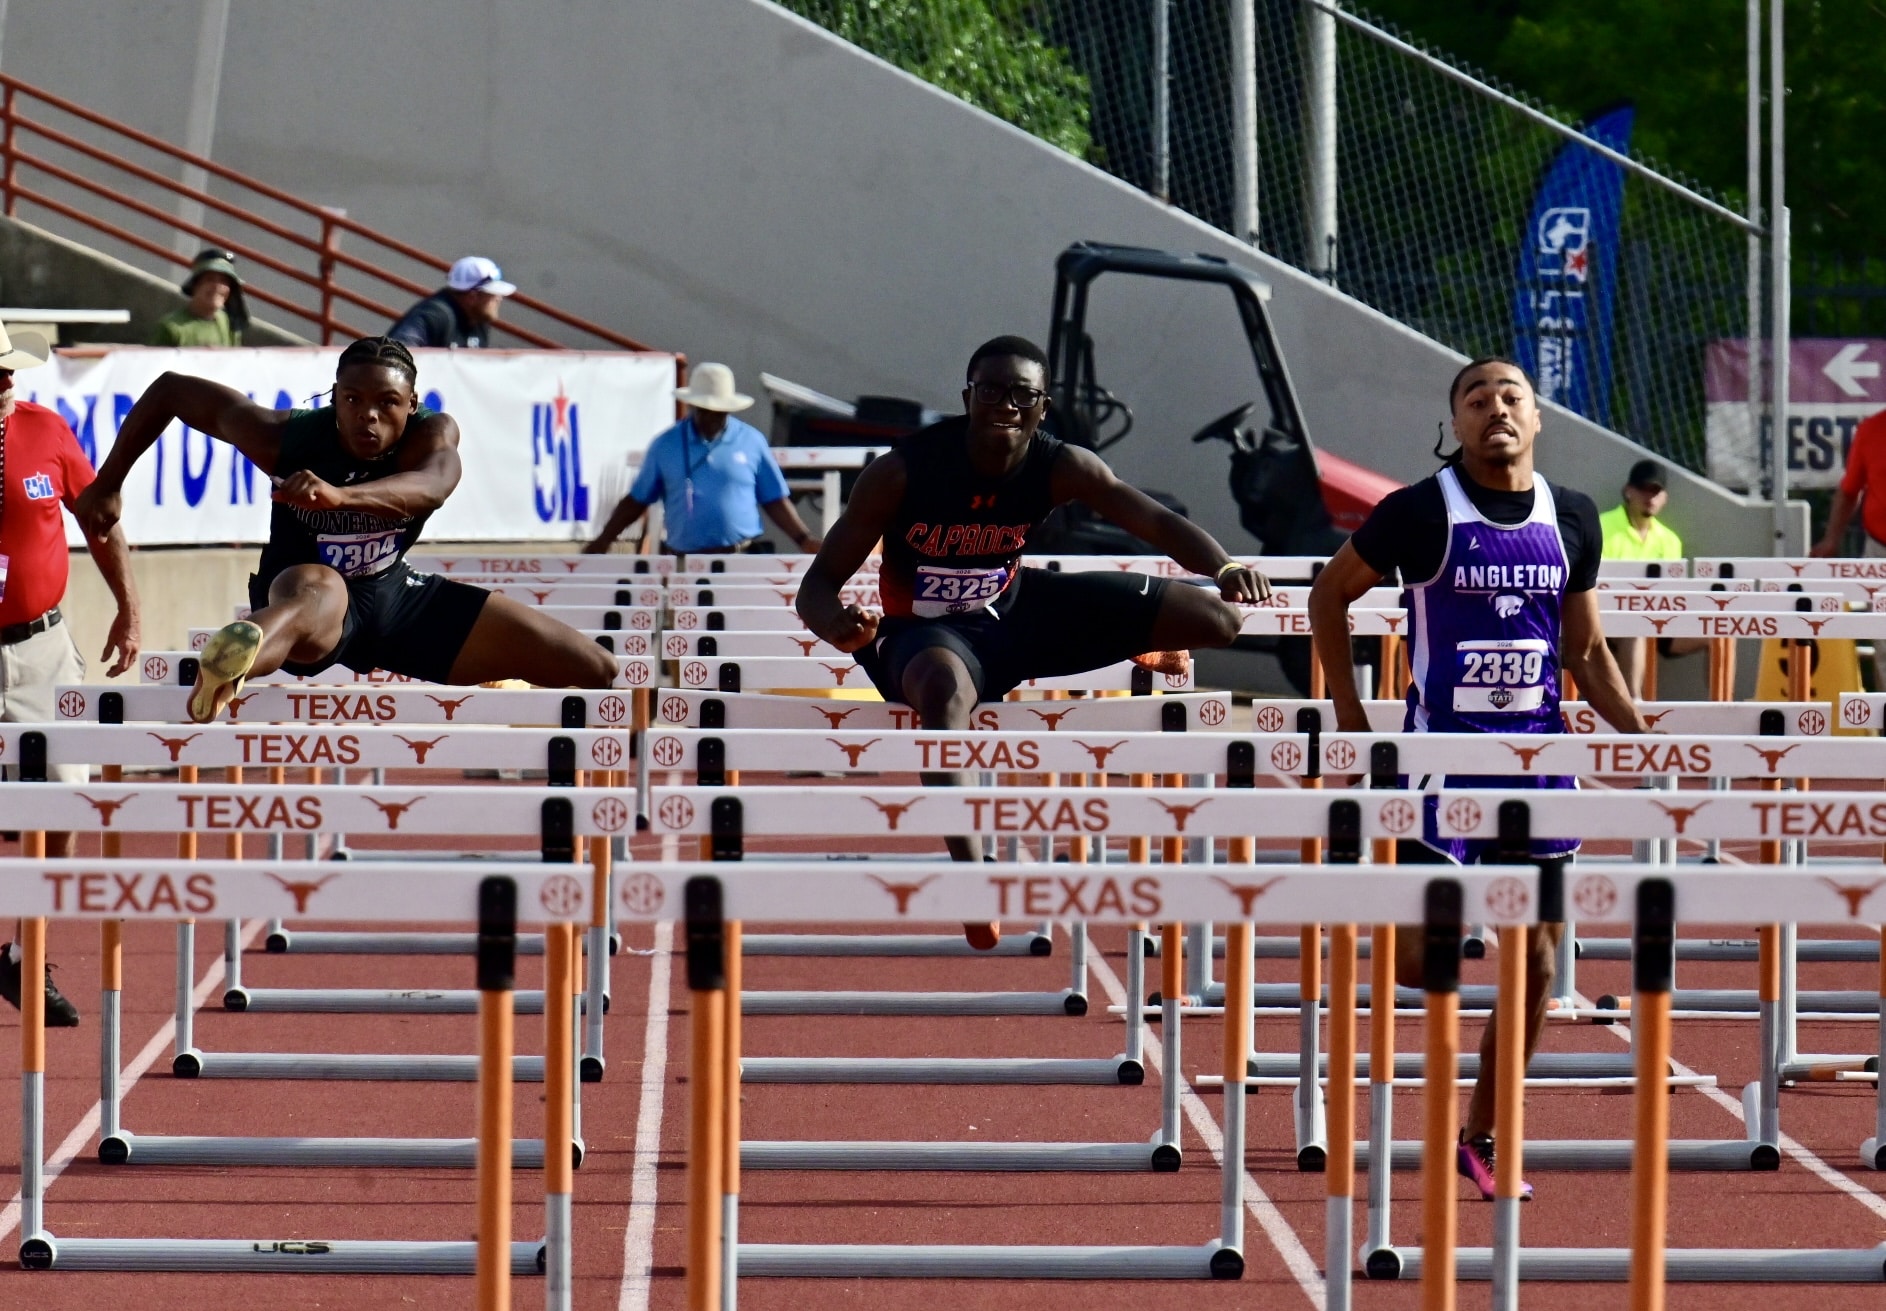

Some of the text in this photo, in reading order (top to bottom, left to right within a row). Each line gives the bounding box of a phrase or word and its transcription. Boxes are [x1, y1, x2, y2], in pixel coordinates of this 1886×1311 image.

[905, 522, 1030, 557] CAPROCK
[326, 534, 396, 570] 2304
[480, 559, 541, 573] TEXAS
[1454, 565, 1562, 588] ANGLETON
[921, 575, 998, 600] 2325
[1614, 595, 1687, 611] TEXAS
[1700, 617, 1778, 636] TEXAS
[626, 637, 645, 654] SEC
[667, 637, 687, 656] SEC
[145, 658, 167, 679] SEC
[626, 662, 647, 684] SEC
[685, 663, 706, 684] SEC
[1462, 652, 1543, 685] 2339
[59, 692, 84, 716] SEC
[288, 694, 397, 721] TEXAS
[600, 697, 624, 721] SEC
[663, 697, 687, 721] SEC
[1488, 694, 1513, 702] STATE
[1200, 701, 1224, 725] SEC
[1258, 707, 1283, 731] SEC
[1799, 710, 1824, 734] SEC
[1845, 700, 1869, 724] SEC
[234, 734, 360, 765] TEXAS
[593, 737, 621, 765] SEC
[654, 737, 682, 766] SEC
[914, 740, 1040, 770] TEXAS
[1272, 742, 1300, 770] SEC
[1327, 741, 1355, 769] SEC
[1588, 743, 1712, 773] TEXAS
[179, 795, 323, 830] TEXAS
[965, 798, 1110, 833] TEXAS
[44, 872, 216, 915] TEXAS
[989, 876, 1162, 918] TEXAS
[253, 1242, 333, 1254] UCS
